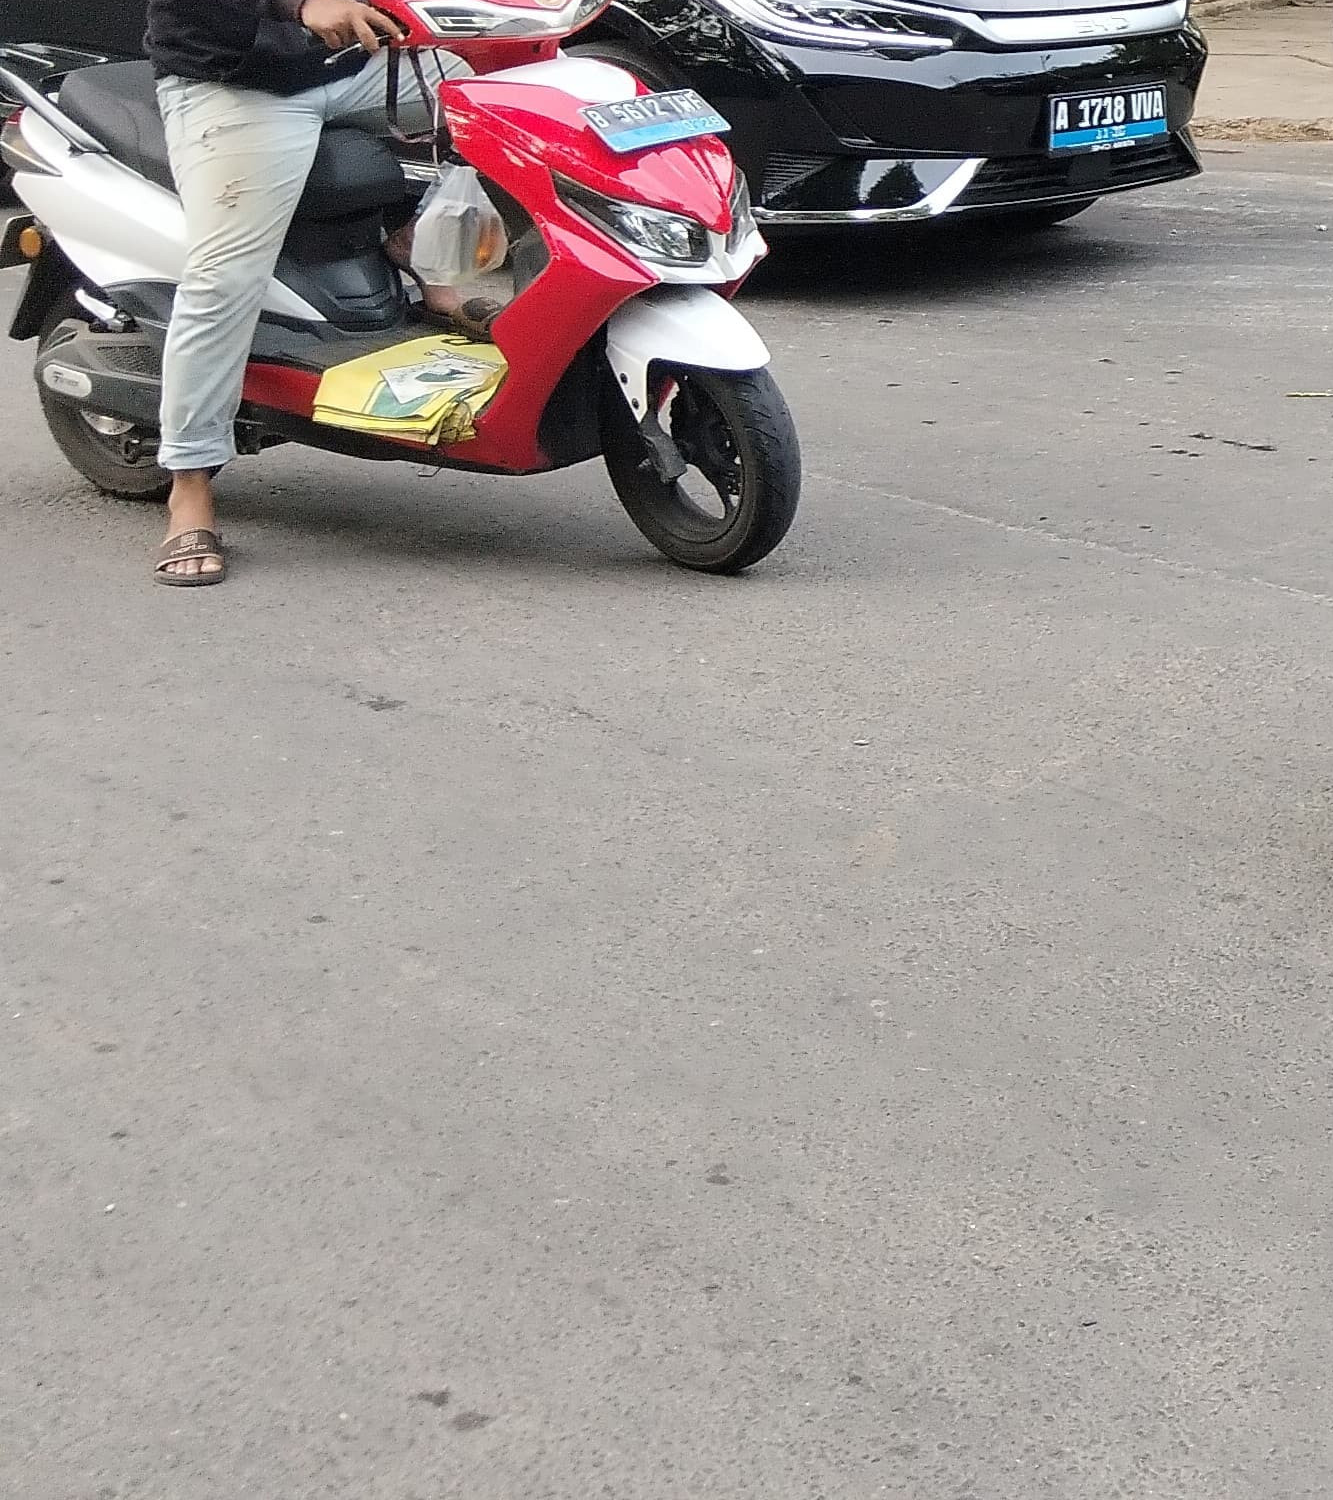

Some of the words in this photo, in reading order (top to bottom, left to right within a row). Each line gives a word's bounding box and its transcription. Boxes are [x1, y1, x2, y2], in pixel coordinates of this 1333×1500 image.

[587, 109, 611, 129] B
[609, 98, 669, 124] 5612
[1055, 101, 1069, 131] A
[1078, 95, 1126, 128] 1718
